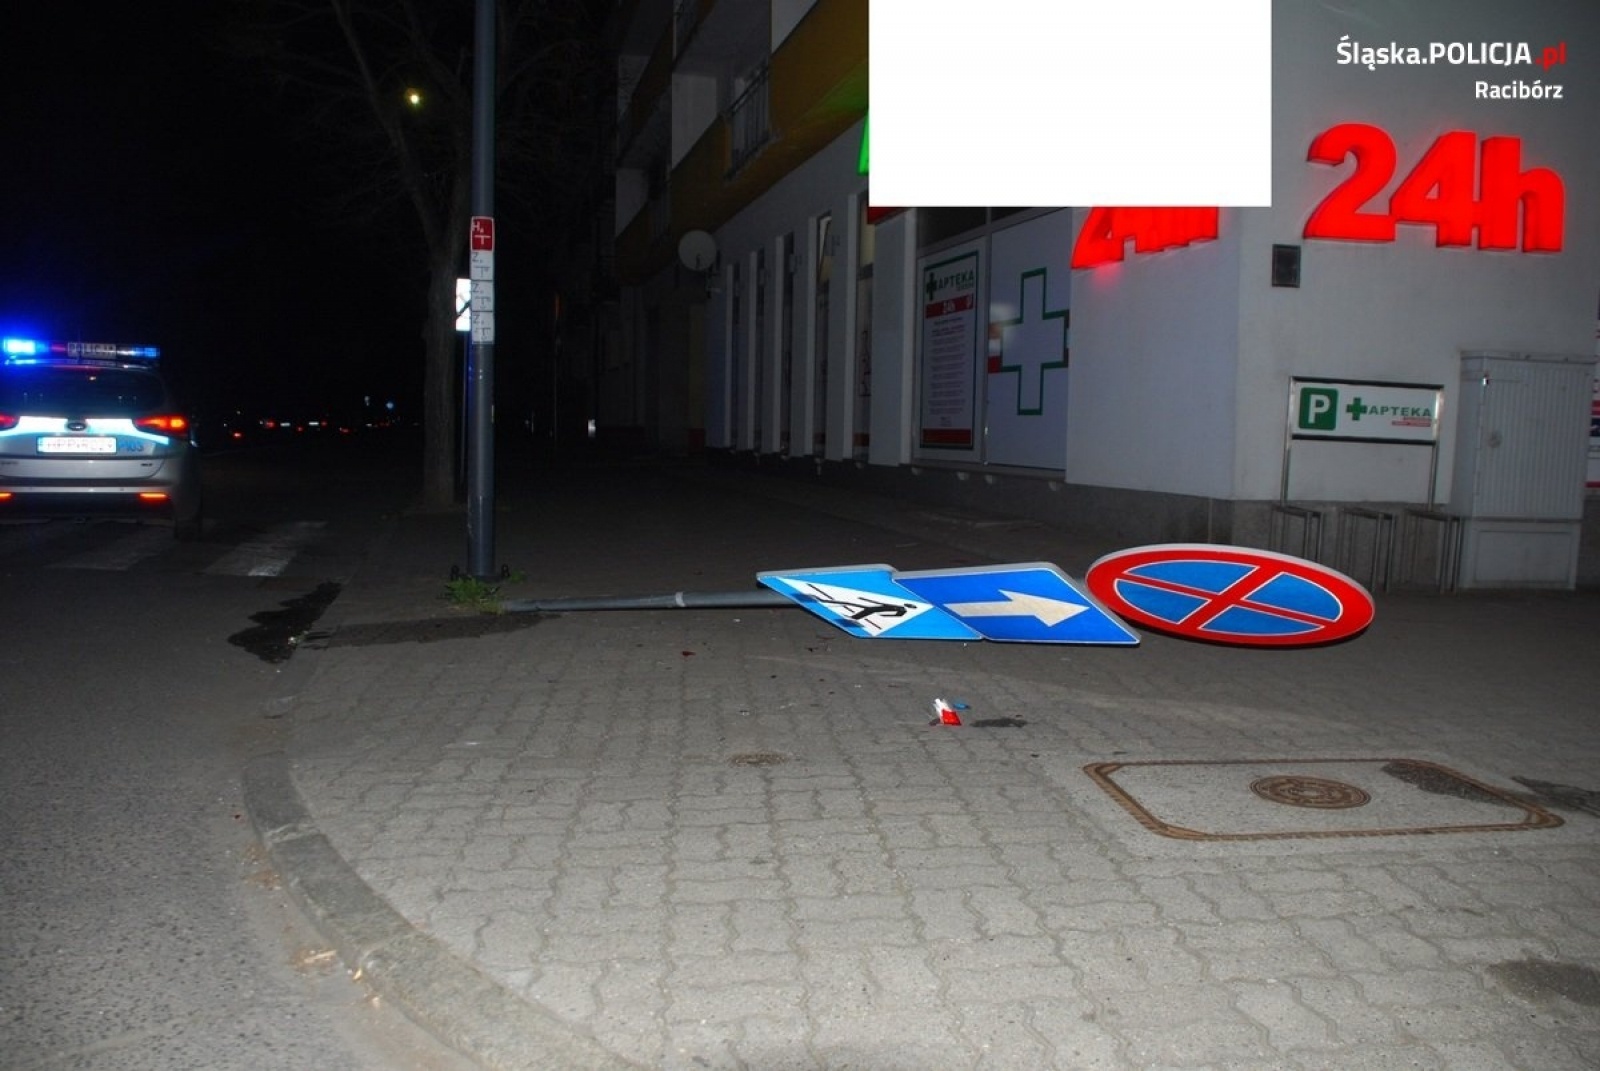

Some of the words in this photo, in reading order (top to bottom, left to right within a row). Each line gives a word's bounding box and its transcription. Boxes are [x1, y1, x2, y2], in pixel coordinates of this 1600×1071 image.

[1303, 123, 1565, 254] 24h
[939, 270, 973, 288] APTEKA
[1308, 394, 1331, 424] P
[1368, 405, 1431, 417] APTEKA
